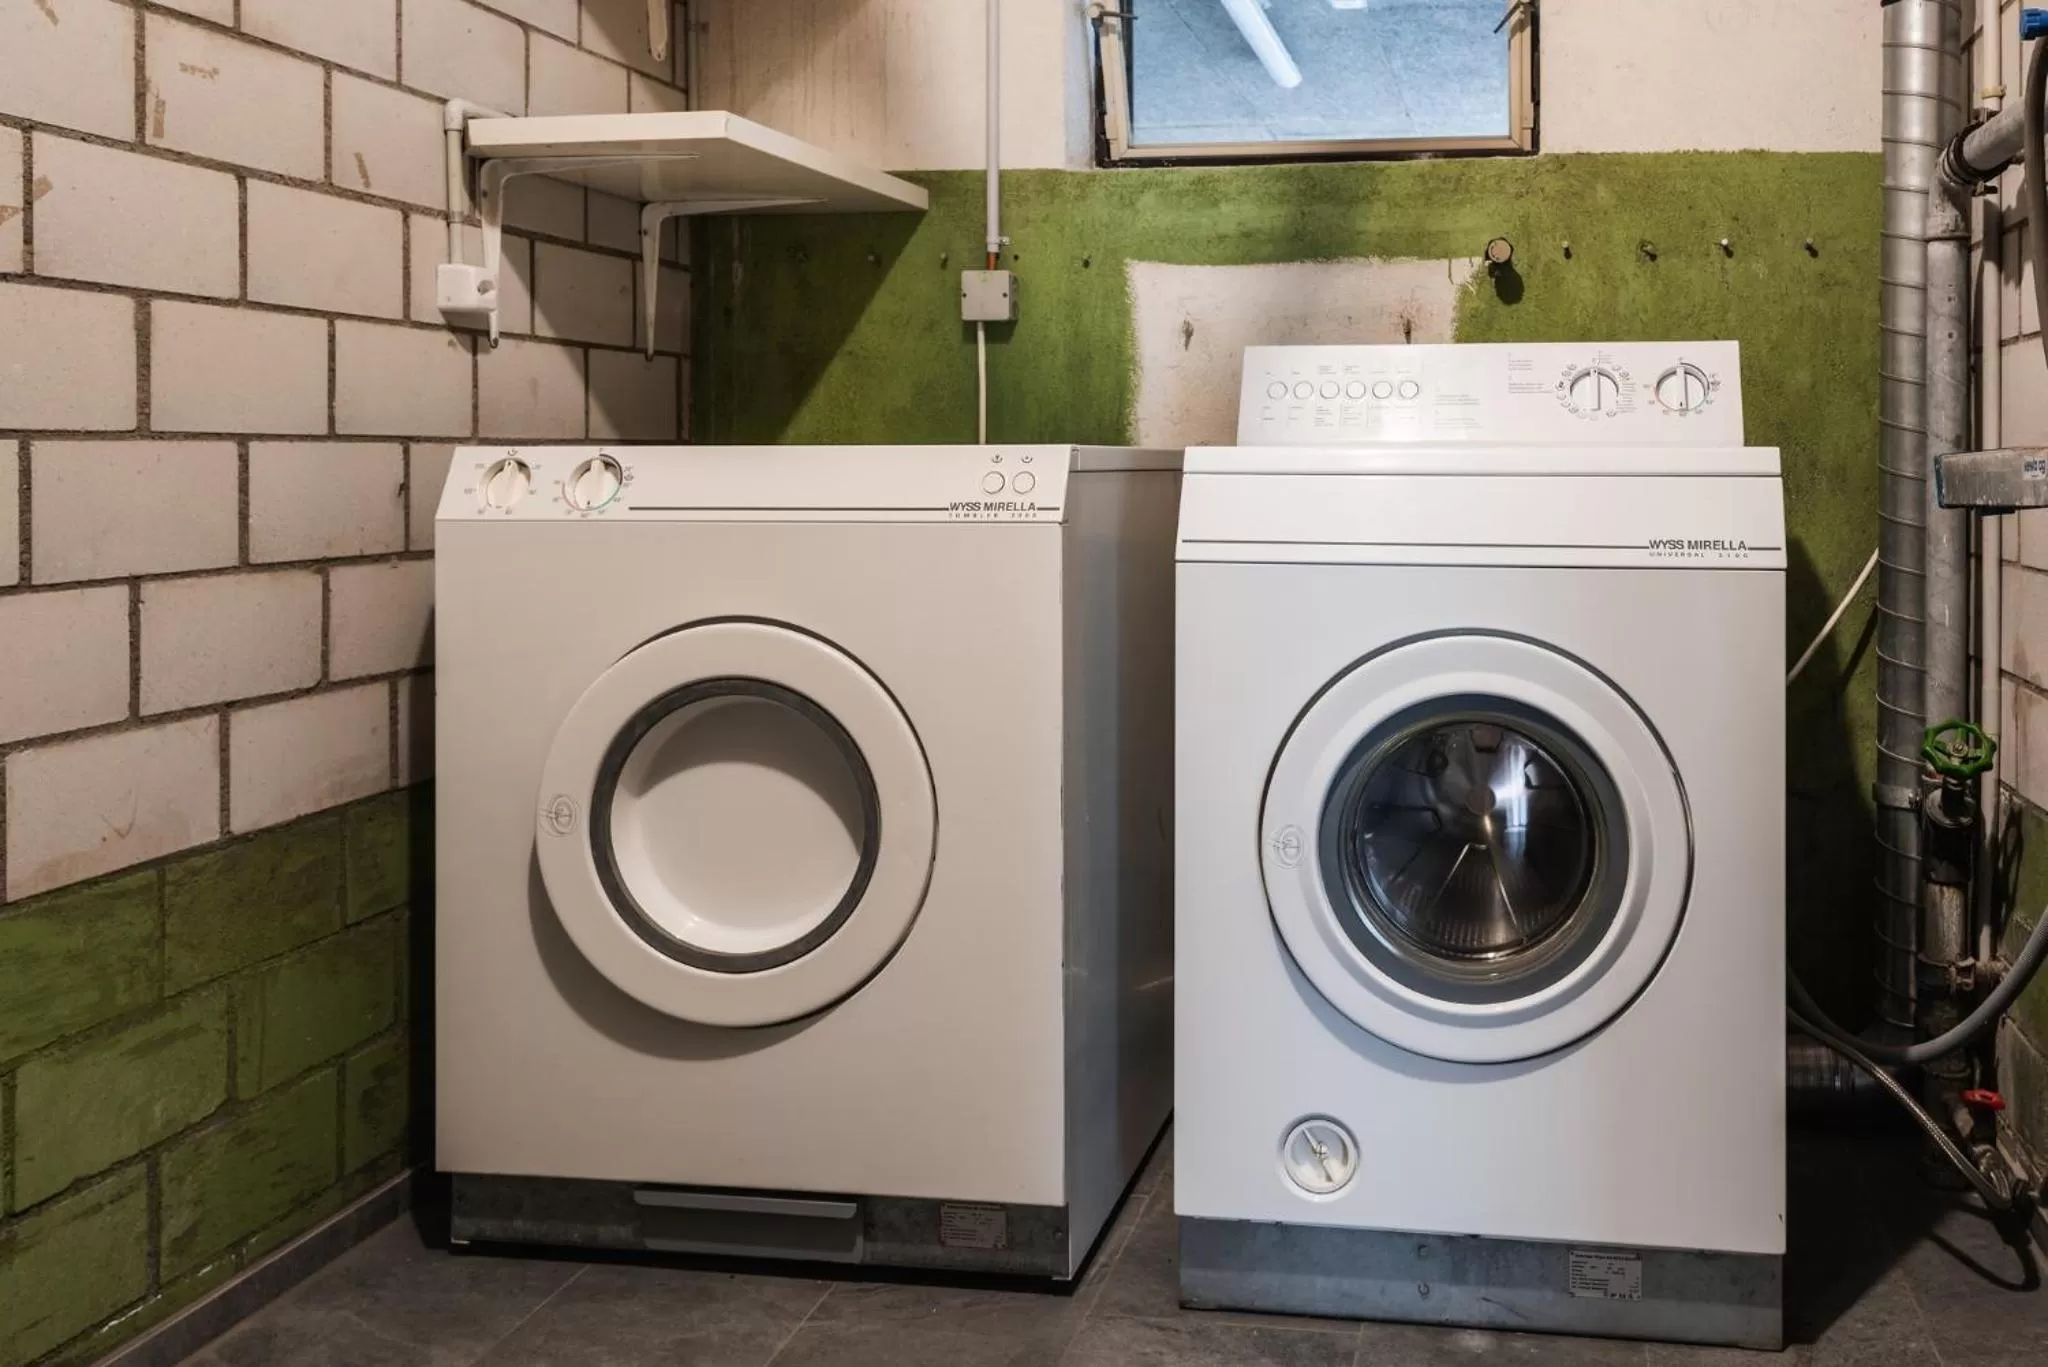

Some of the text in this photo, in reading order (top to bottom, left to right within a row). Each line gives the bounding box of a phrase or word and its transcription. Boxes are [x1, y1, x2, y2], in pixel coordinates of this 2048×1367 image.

[949, 502, 1036, 512] WYSS MIRELLA
[1649, 540, 1747, 551] WYSS MIRELLA
